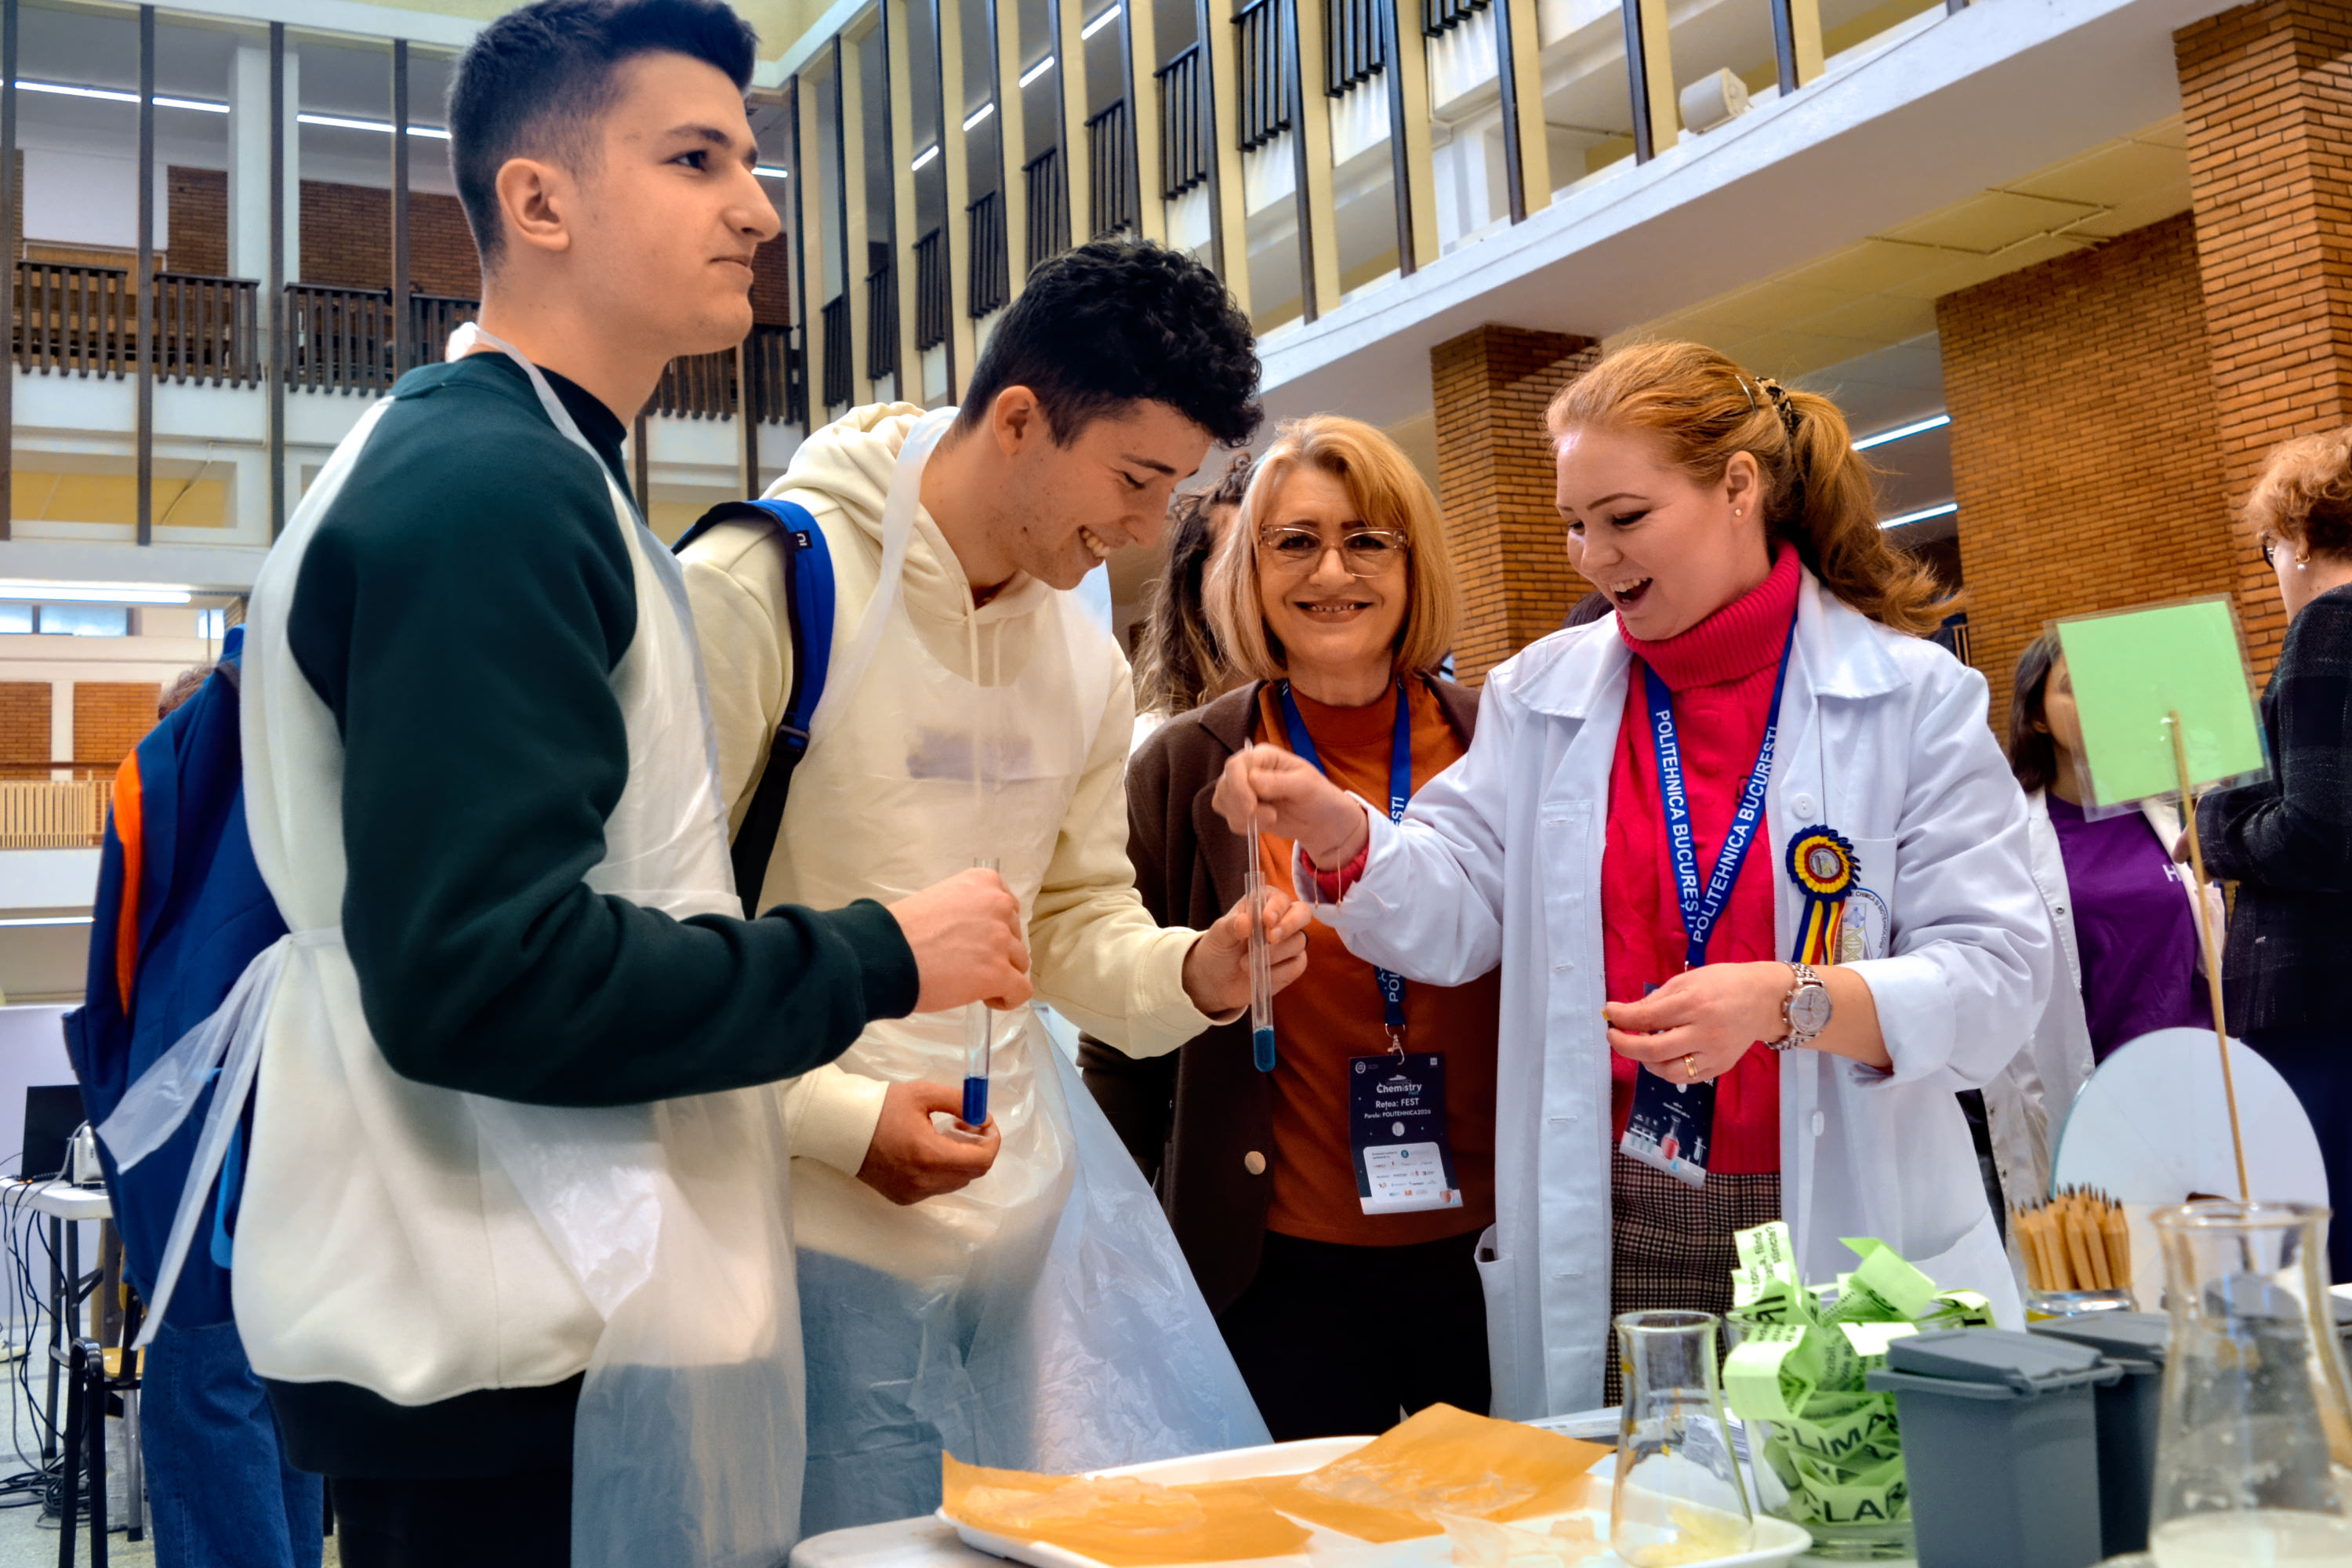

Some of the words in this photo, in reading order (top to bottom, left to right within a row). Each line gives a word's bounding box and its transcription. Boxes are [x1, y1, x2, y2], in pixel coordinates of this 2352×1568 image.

[1656, 710, 1686, 821] POLITEHNICA
[1672, 824, 1699, 928] BUCUREȘ
[1693, 825, 1750, 942] POLITEHNICA
[1376, 1082, 1422, 1094] Chemistry
[1400, 1098, 1420, 1106] FEST
